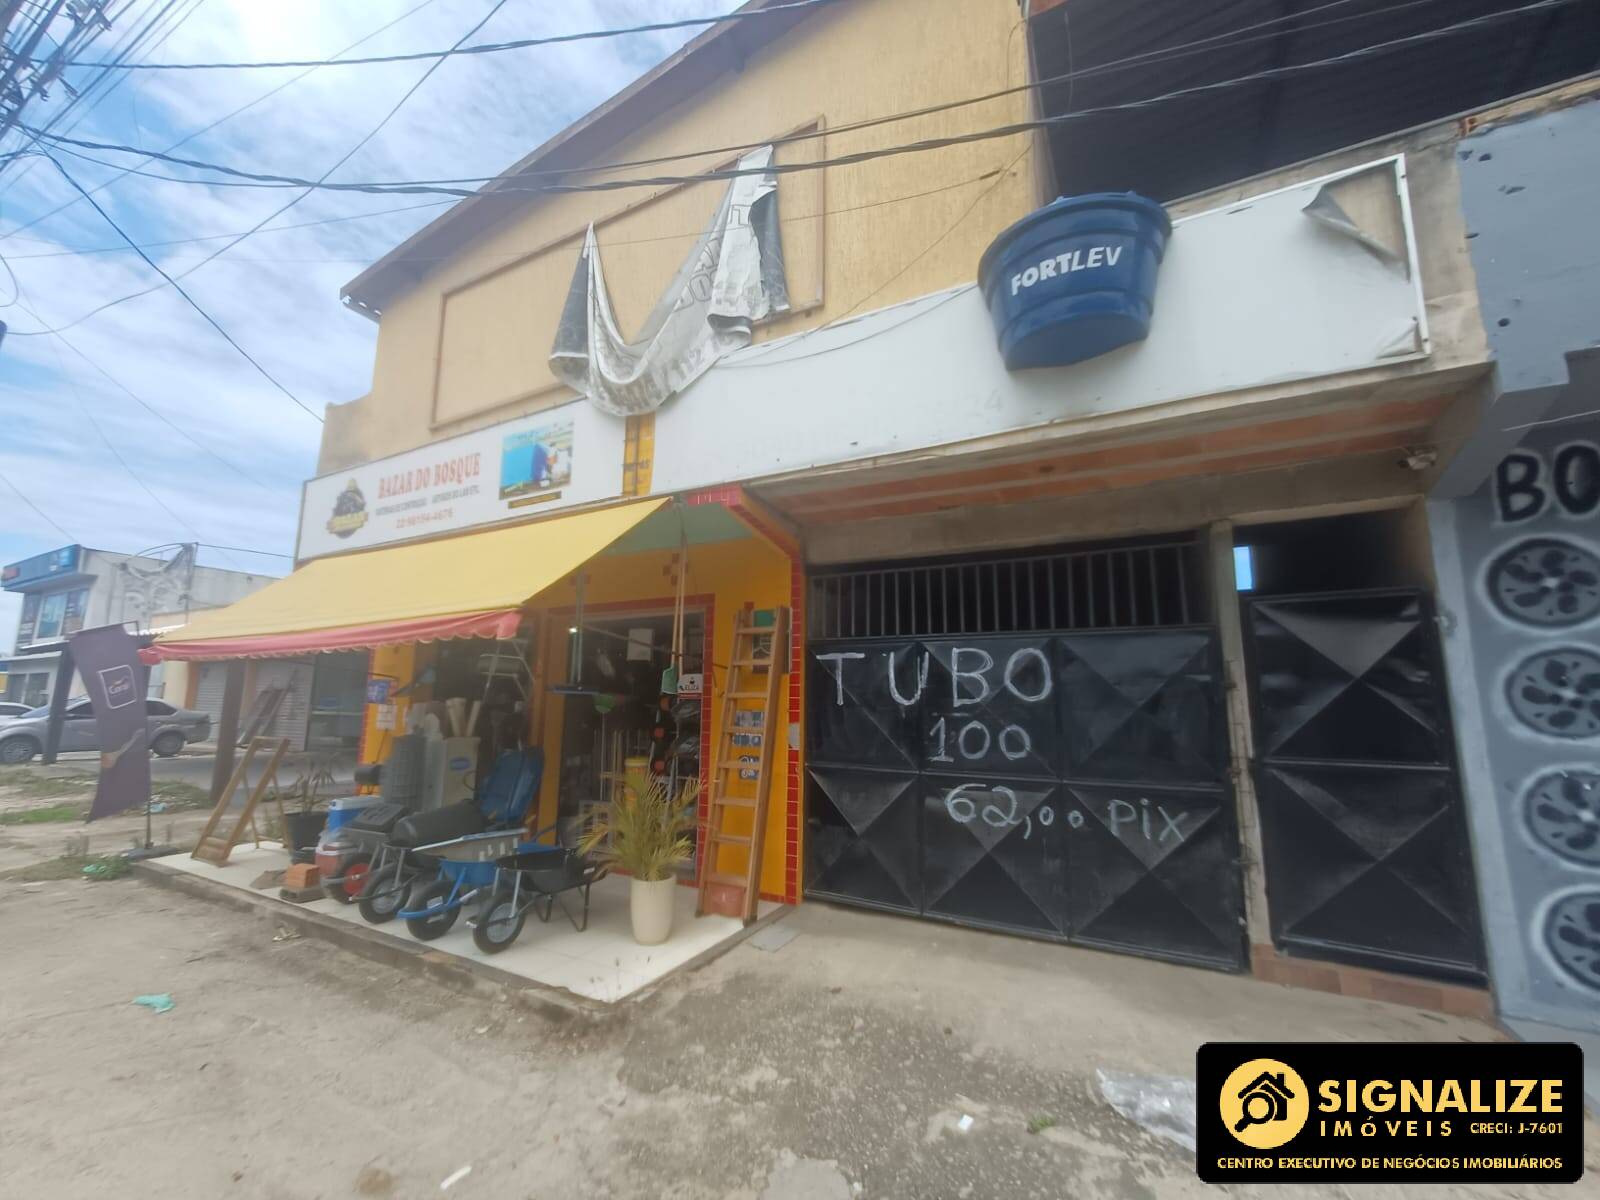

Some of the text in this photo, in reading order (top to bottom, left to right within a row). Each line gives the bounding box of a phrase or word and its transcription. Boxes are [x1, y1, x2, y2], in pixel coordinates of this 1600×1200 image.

[1010, 246, 1123, 297] FORTLEV
[378, 470, 413, 500] BAZAR
[414, 466, 431, 491] DO
[433, 452, 481, 486] BOSQUE
[816, 646, 1053, 707] TUBO
[928, 716, 1031, 763] 100
